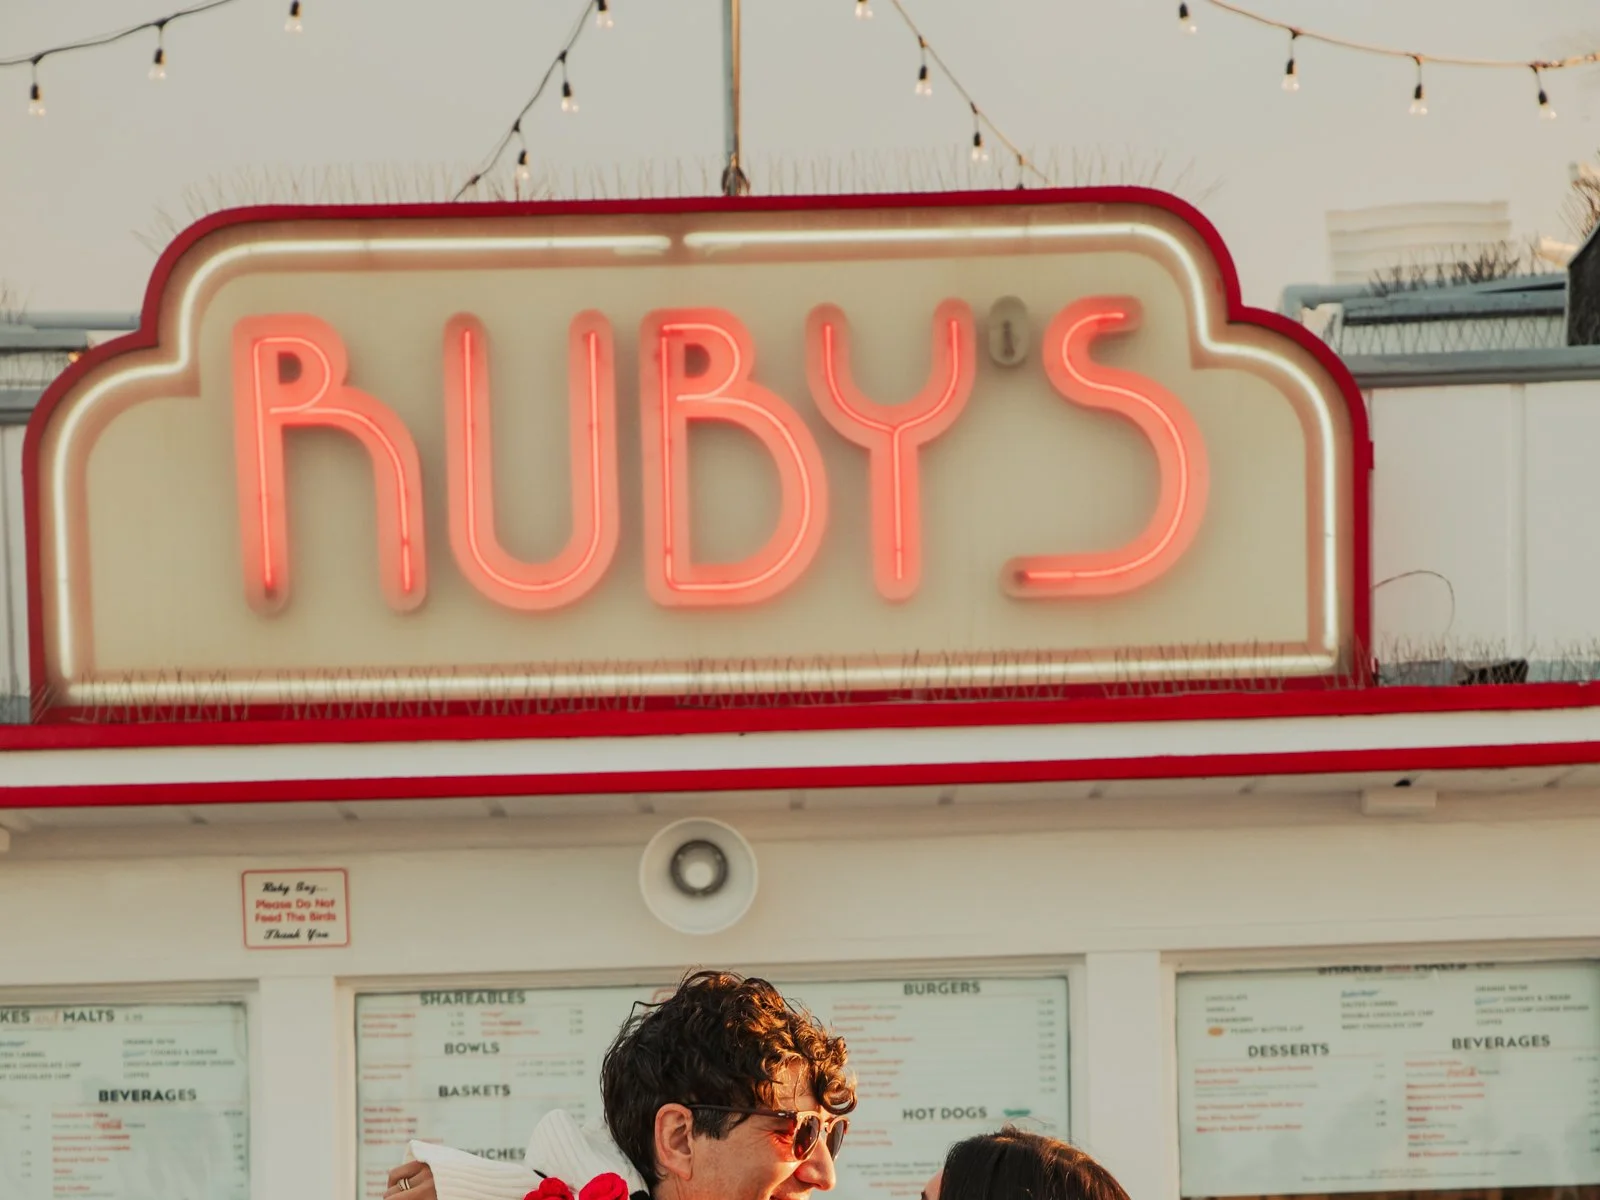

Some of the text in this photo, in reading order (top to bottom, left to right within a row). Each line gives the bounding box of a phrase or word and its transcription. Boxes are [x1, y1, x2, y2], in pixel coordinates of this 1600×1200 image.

[233, 295, 1210, 612] RUBY'S
[262, 881, 290, 896] Ruby
[255, 898, 335, 909] Please Do Not
[255, 911, 336, 922] Feed The Birds
[263, 928, 329, 942] Thank You
[903, 981, 982, 996] BURGERS
[419, 990, 526, 1006] SHAREABLES
[63, 1009, 115, 1022] MALTS
[443, 1042, 501, 1055] BOWLS
[1247, 1042, 1331, 1058] DESSERTS
[1451, 1034, 1552, 1051] BEVERAGES
[98, 1088, 197, 1103] BEVERAGES
[438, 1084, 511, 1098] BASKETS
[902, 1106, 988, 1121] HOT DOGS
